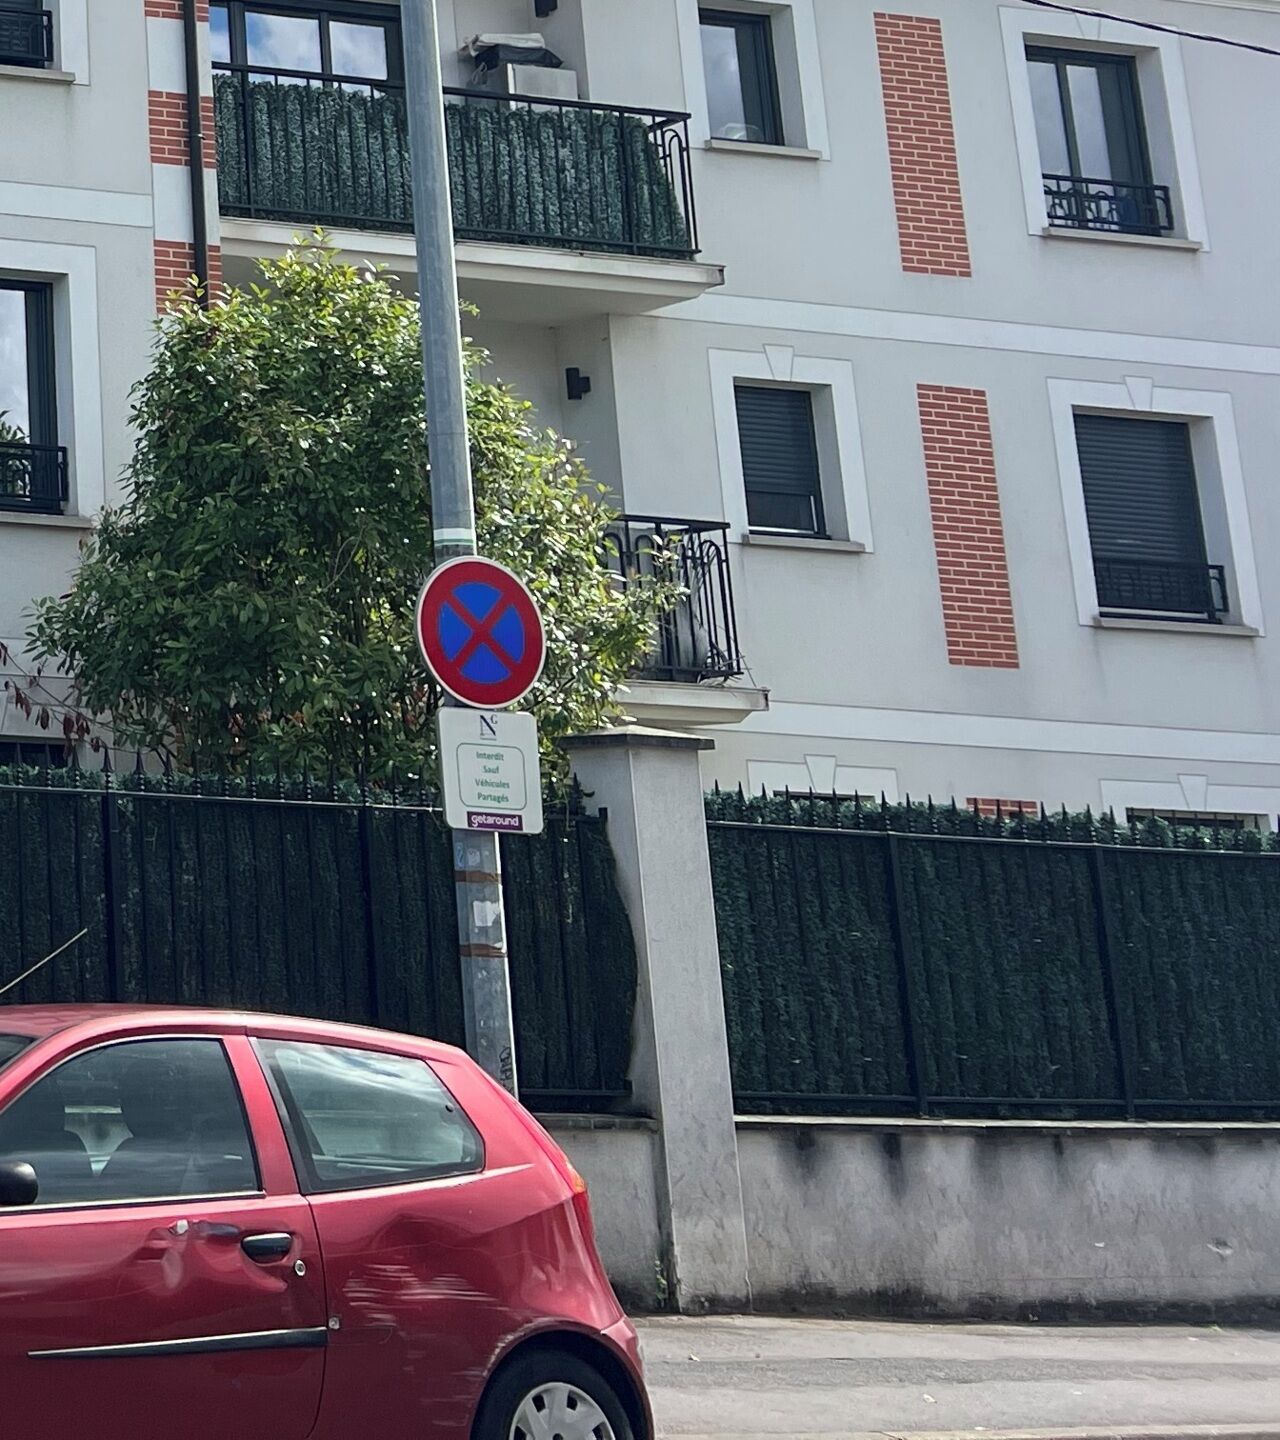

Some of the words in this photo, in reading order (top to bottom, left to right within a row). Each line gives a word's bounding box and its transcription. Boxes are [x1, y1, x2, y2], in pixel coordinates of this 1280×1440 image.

[476, 751, 504, 761] Interdit
[482, 765, 499, 774] Sauf
[475, 778, 510, 789] Véhicules
[477, 791, 509, 804] Partagés
[471, 814, 519, 827] getaround
